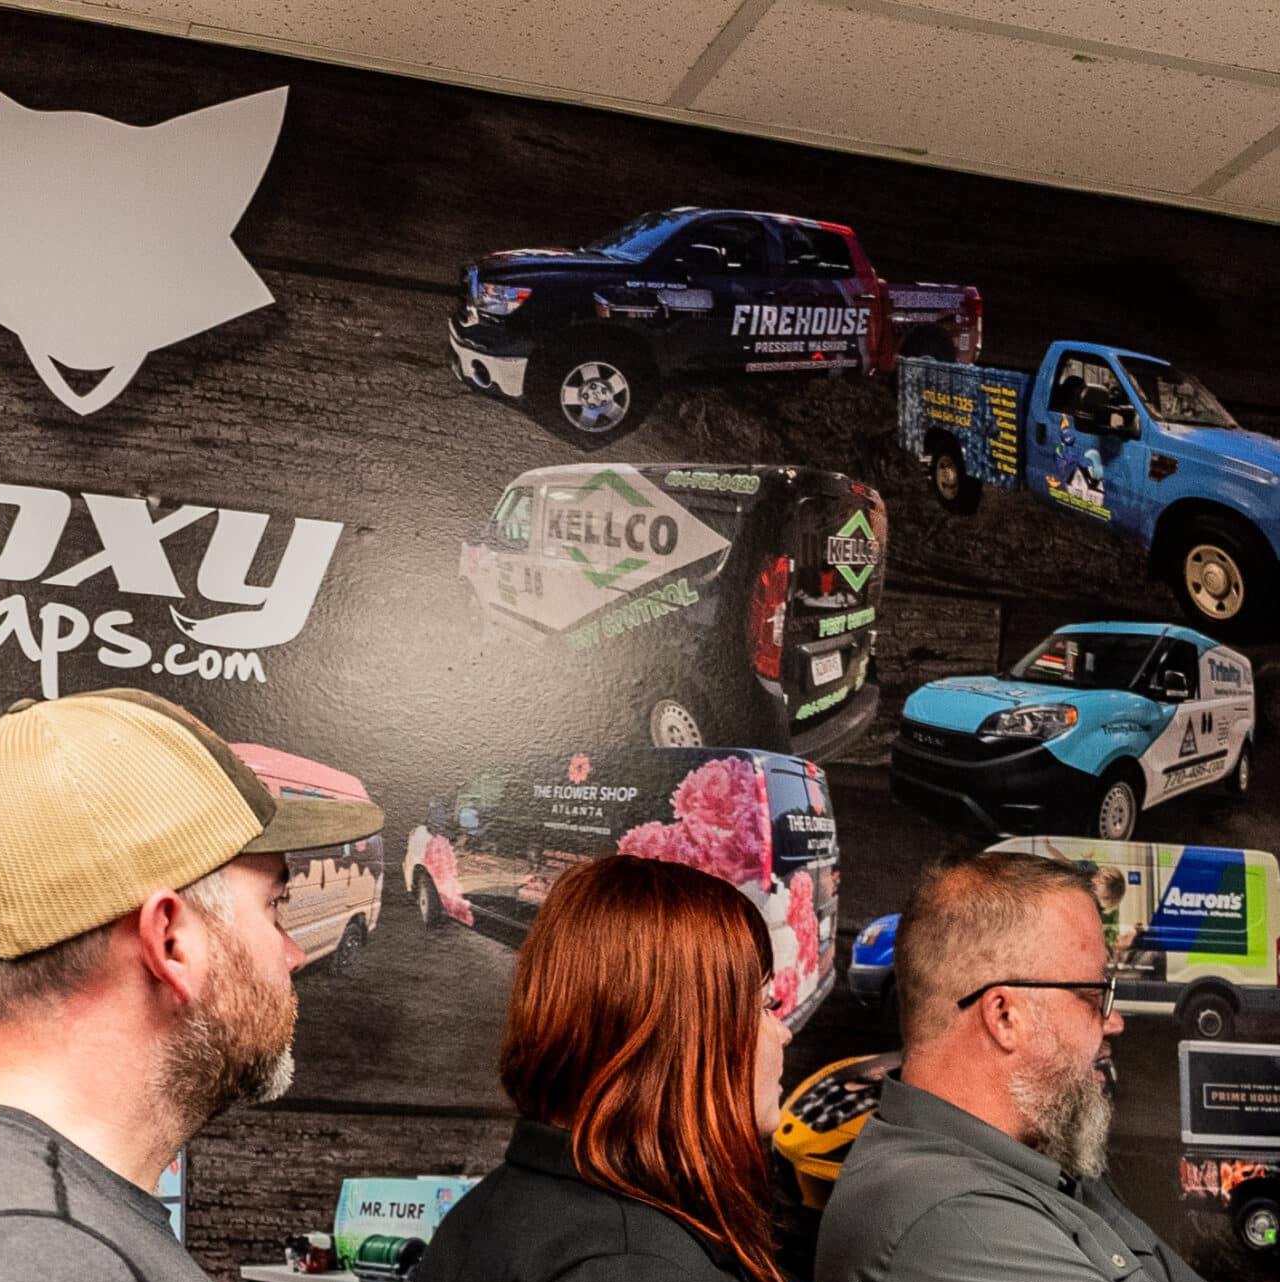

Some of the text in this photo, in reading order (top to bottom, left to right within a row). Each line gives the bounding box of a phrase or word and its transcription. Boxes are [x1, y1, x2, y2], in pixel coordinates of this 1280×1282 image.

[730, 304, 871, 337] FIREHOUSE
[754, 340, 848, 353] PRESSURE WASHING
[547, 509, 679, 556] KELLCO
[827, 536, 880, 565] KELLCO
[601, 577, 700, 638] CONTROL
[819, 614, 847, 638] PEST
[533, 785, 639, 802] THE FLOWER SHOP
[551, 804, 604, 818] ATLANTA
[1163, 886, 1243, 911] Aaron's
[1211, 1090, 1247, 1103] PRIME
[359, 1200, 426, 1220] MR. TURF
